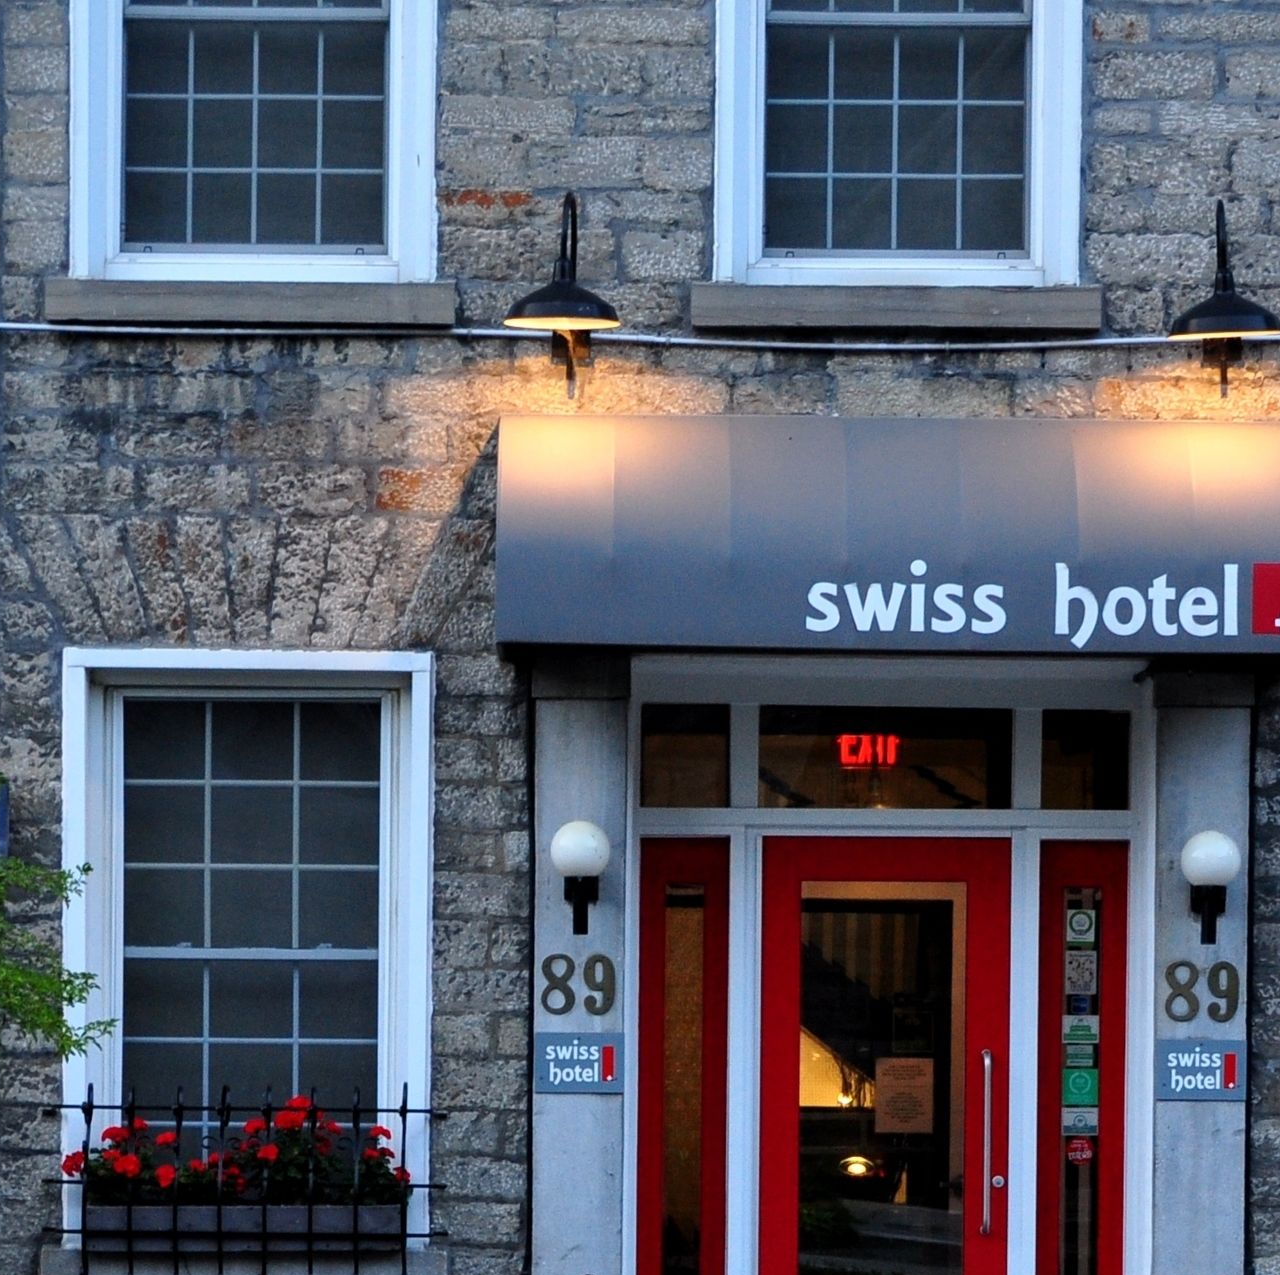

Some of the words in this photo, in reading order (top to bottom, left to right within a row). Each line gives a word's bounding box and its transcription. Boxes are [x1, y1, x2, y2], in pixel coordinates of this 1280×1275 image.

[806, 559, 1007, 632] swiss
[1055, 562, 1239, 649] hotel
[541, 953, 615, 1016] 89
[1165, 960, 1240, 1023] 89
[545, 1039, 599, 1060] swiss
[1167, 1047, 1221, 1067] swiss
[549, 1061, 599, 1085] hotel
[1171, 1069, 1220, 1092] hotel
